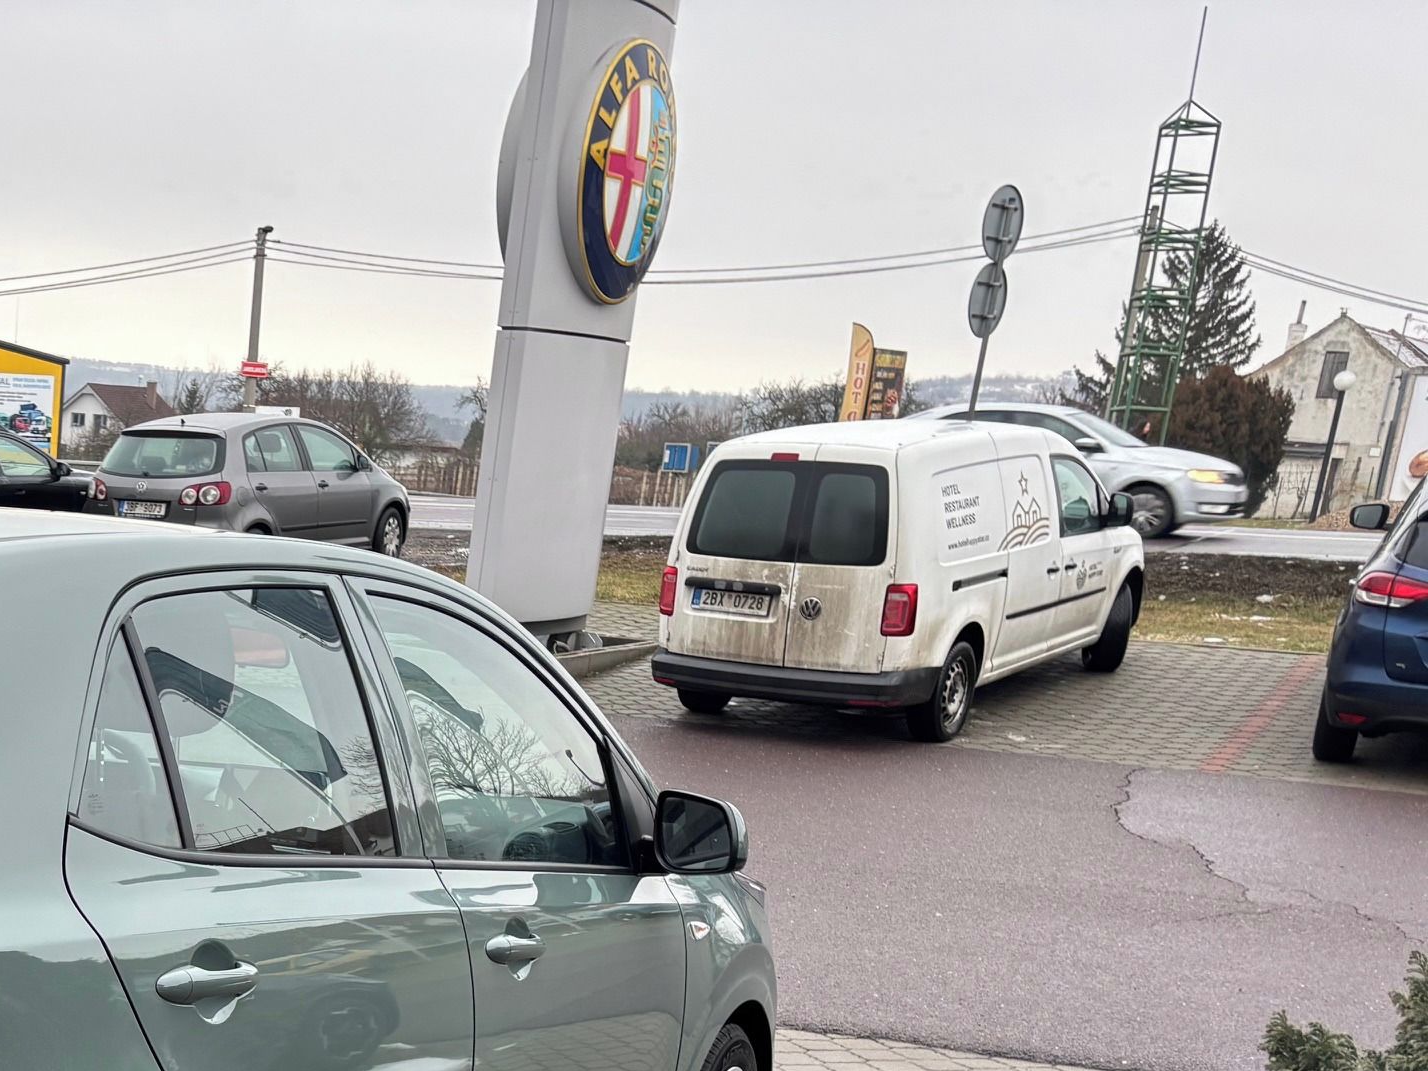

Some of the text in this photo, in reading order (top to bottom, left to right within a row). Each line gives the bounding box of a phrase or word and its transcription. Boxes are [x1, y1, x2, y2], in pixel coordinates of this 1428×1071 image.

[590, 55, 639, 170] ALFA
[941, 484, 961, 497] HOTEL
[944, 496, 980, 513] RESTAURANT
[946, 513, 976, 529] WELLNESS
[702, 591, 764, 611] 2BX 0728
